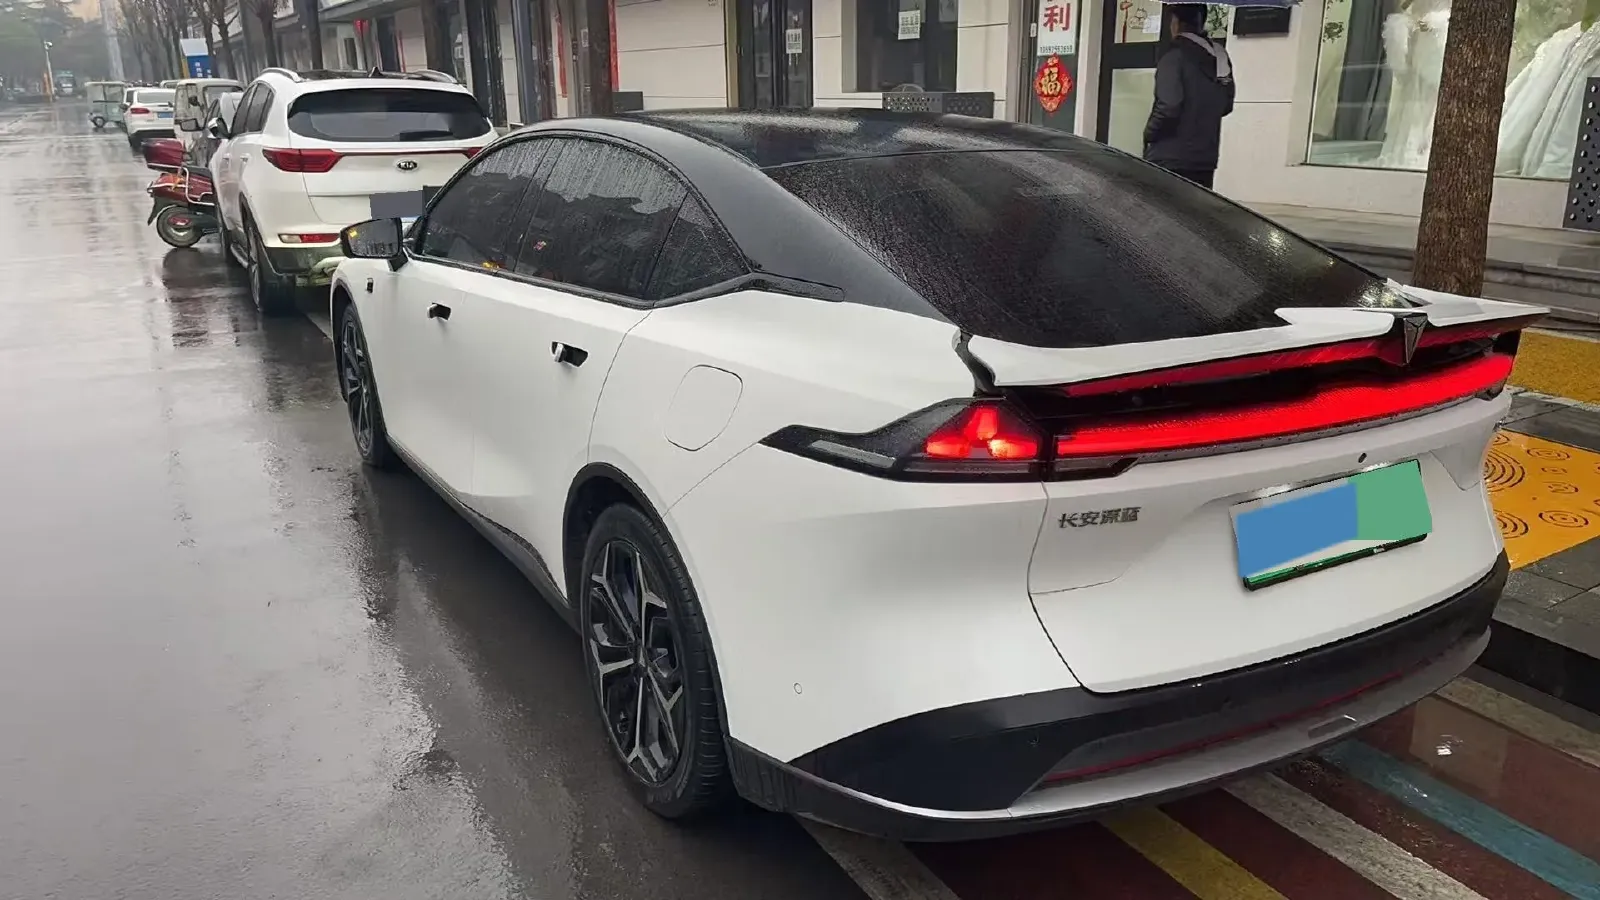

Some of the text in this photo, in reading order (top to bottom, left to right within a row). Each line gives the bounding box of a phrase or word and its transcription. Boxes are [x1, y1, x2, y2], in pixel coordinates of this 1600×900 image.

[1043, 0, 1071, 32] 利
[1041, 67, 1061, 96] 福
[399, 161, 416, 170] KIA
[1058, 507, 1141, 528] 长安深蓝
